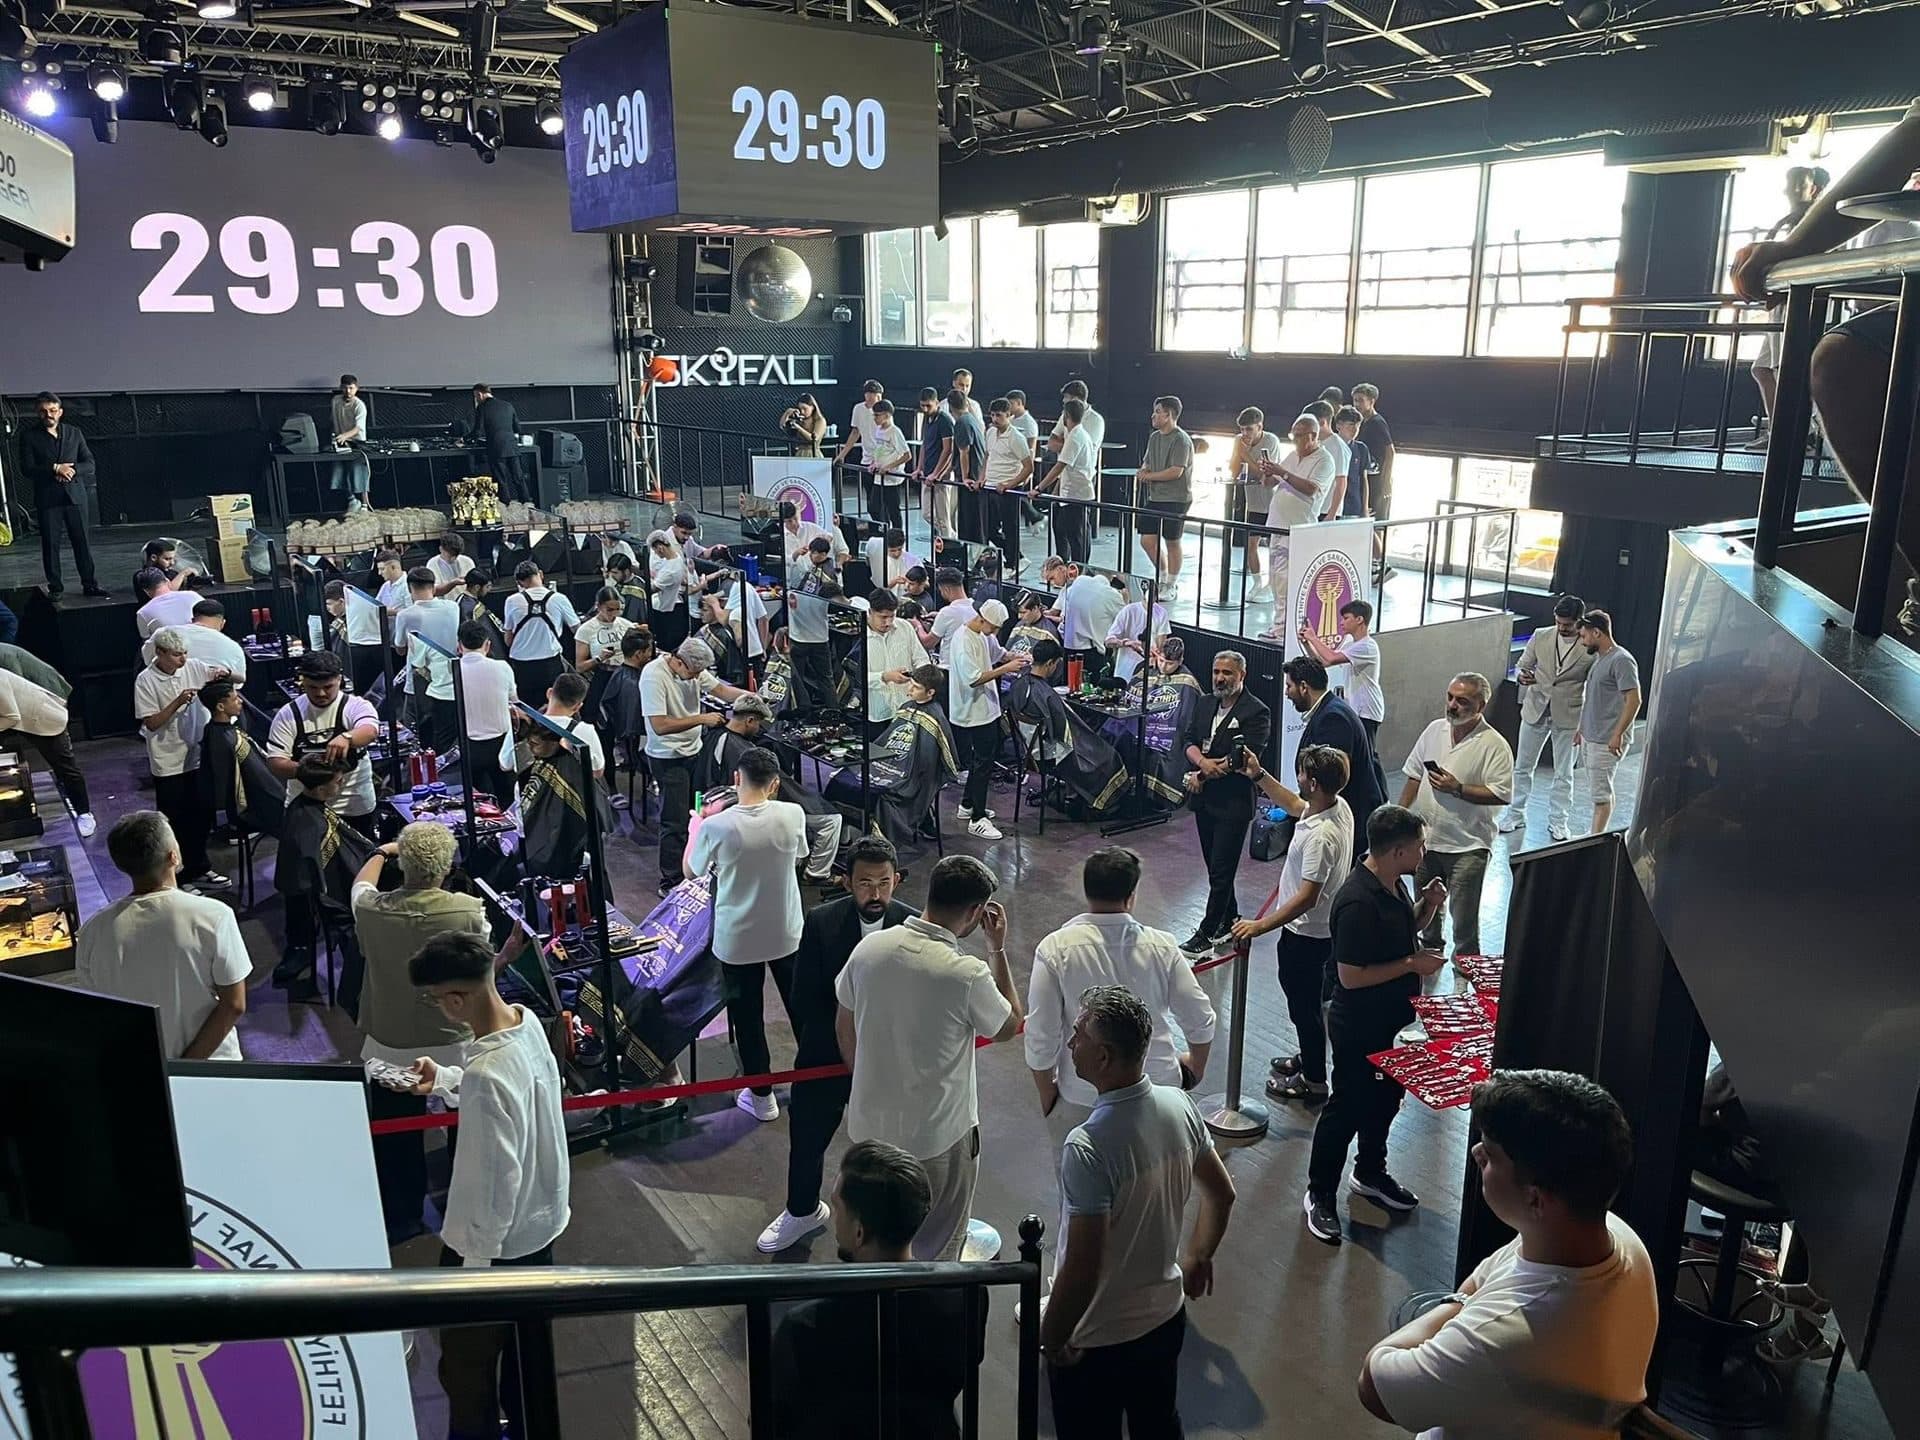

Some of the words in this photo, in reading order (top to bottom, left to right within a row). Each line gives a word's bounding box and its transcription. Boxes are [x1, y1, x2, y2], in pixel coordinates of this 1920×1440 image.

[583, 90, 648, 176] 29:30
[732, 86, 885, 169] 29:30
[130, 213, 499, 316] 29:30
[1320, 635, 1342, 645] ESO
